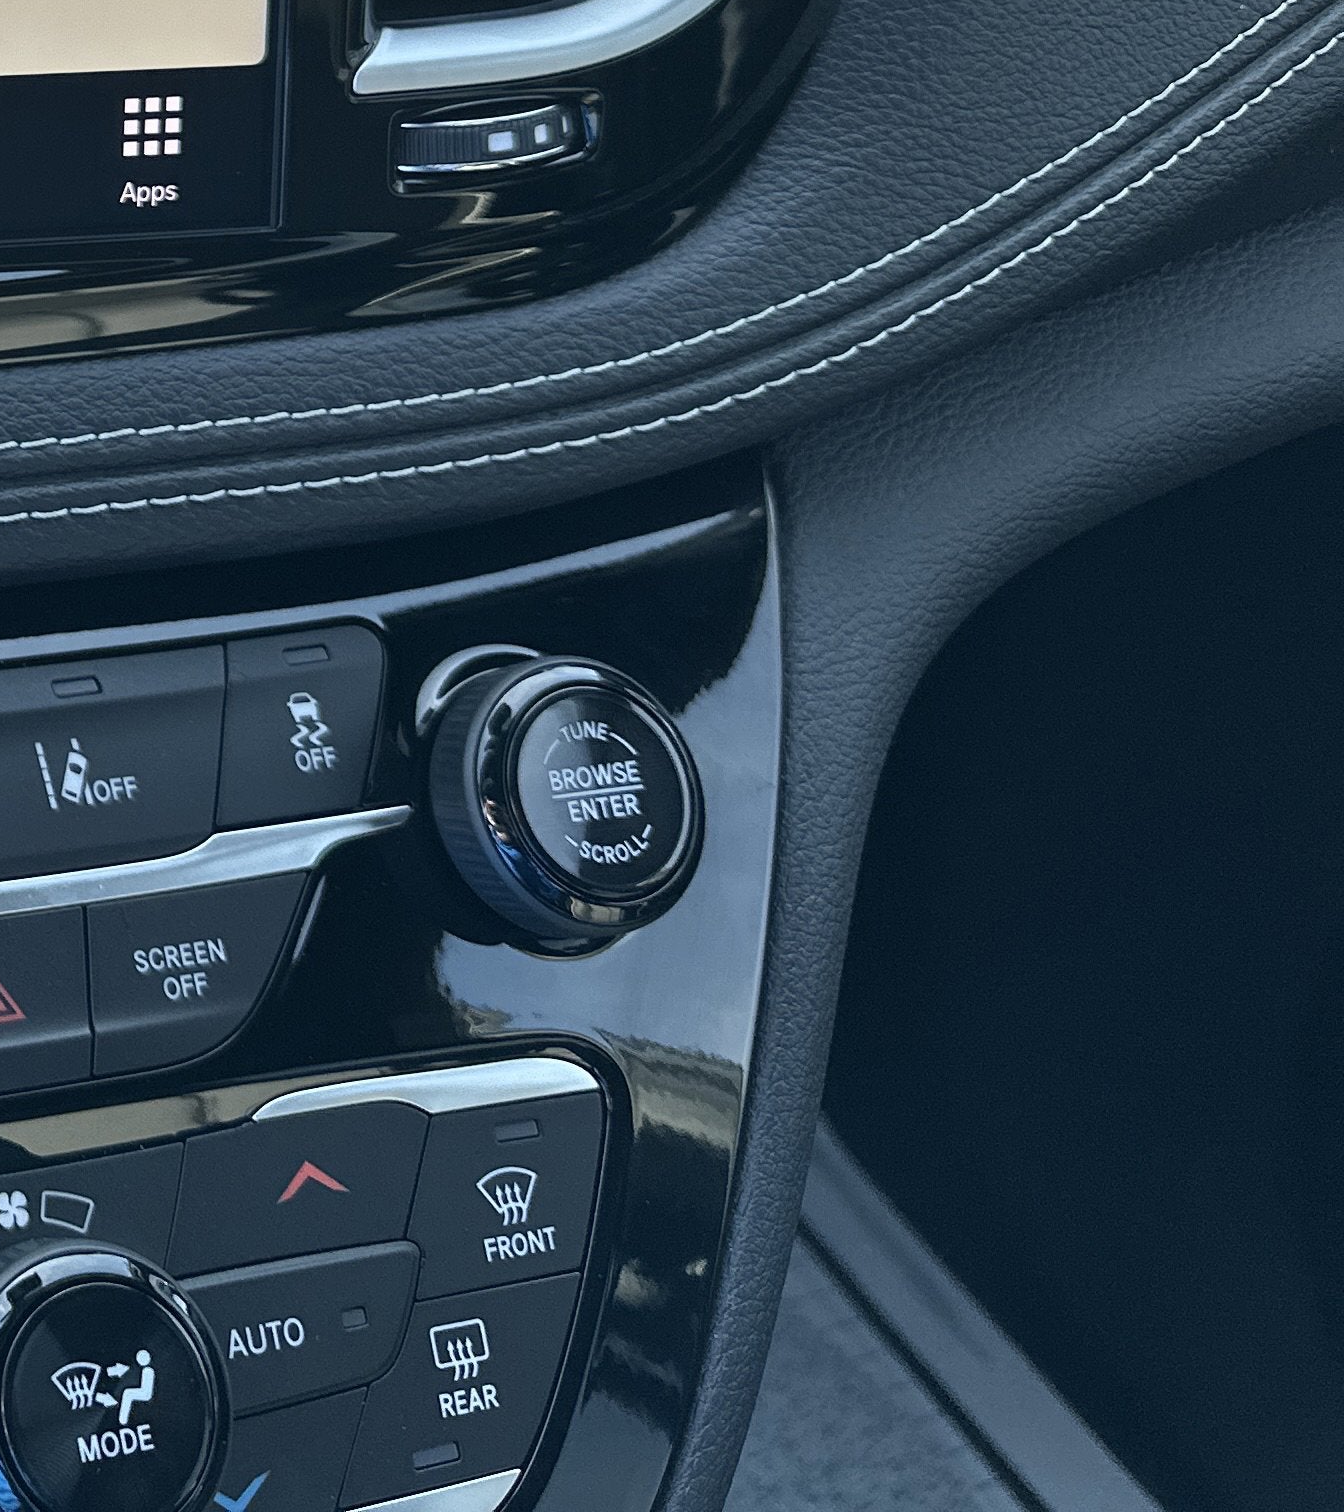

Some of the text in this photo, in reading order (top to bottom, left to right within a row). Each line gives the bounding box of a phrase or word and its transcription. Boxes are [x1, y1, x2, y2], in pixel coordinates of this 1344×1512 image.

[119, 181, 179, 207] Apps
[559, 720, 610, 743] TUNE
[294, 745, 337, 772] OFF
[93, 774, 139, 803] OFF
[548, 759, 642, 792] BROWSE
[567, 793, 643, 823] ENTER
[578, 834, 650, 865] SCROLL
[133, 938, 228, 974] SCREEN
[163, 972, 209, 1000] OFF
[482, 1226, 558, 1263] FRONT
[227, 1317, 306, 1360] AUTO
[437, 1384, 500, 1419] REAR
[76, 1423, 155, 1464] MODE
